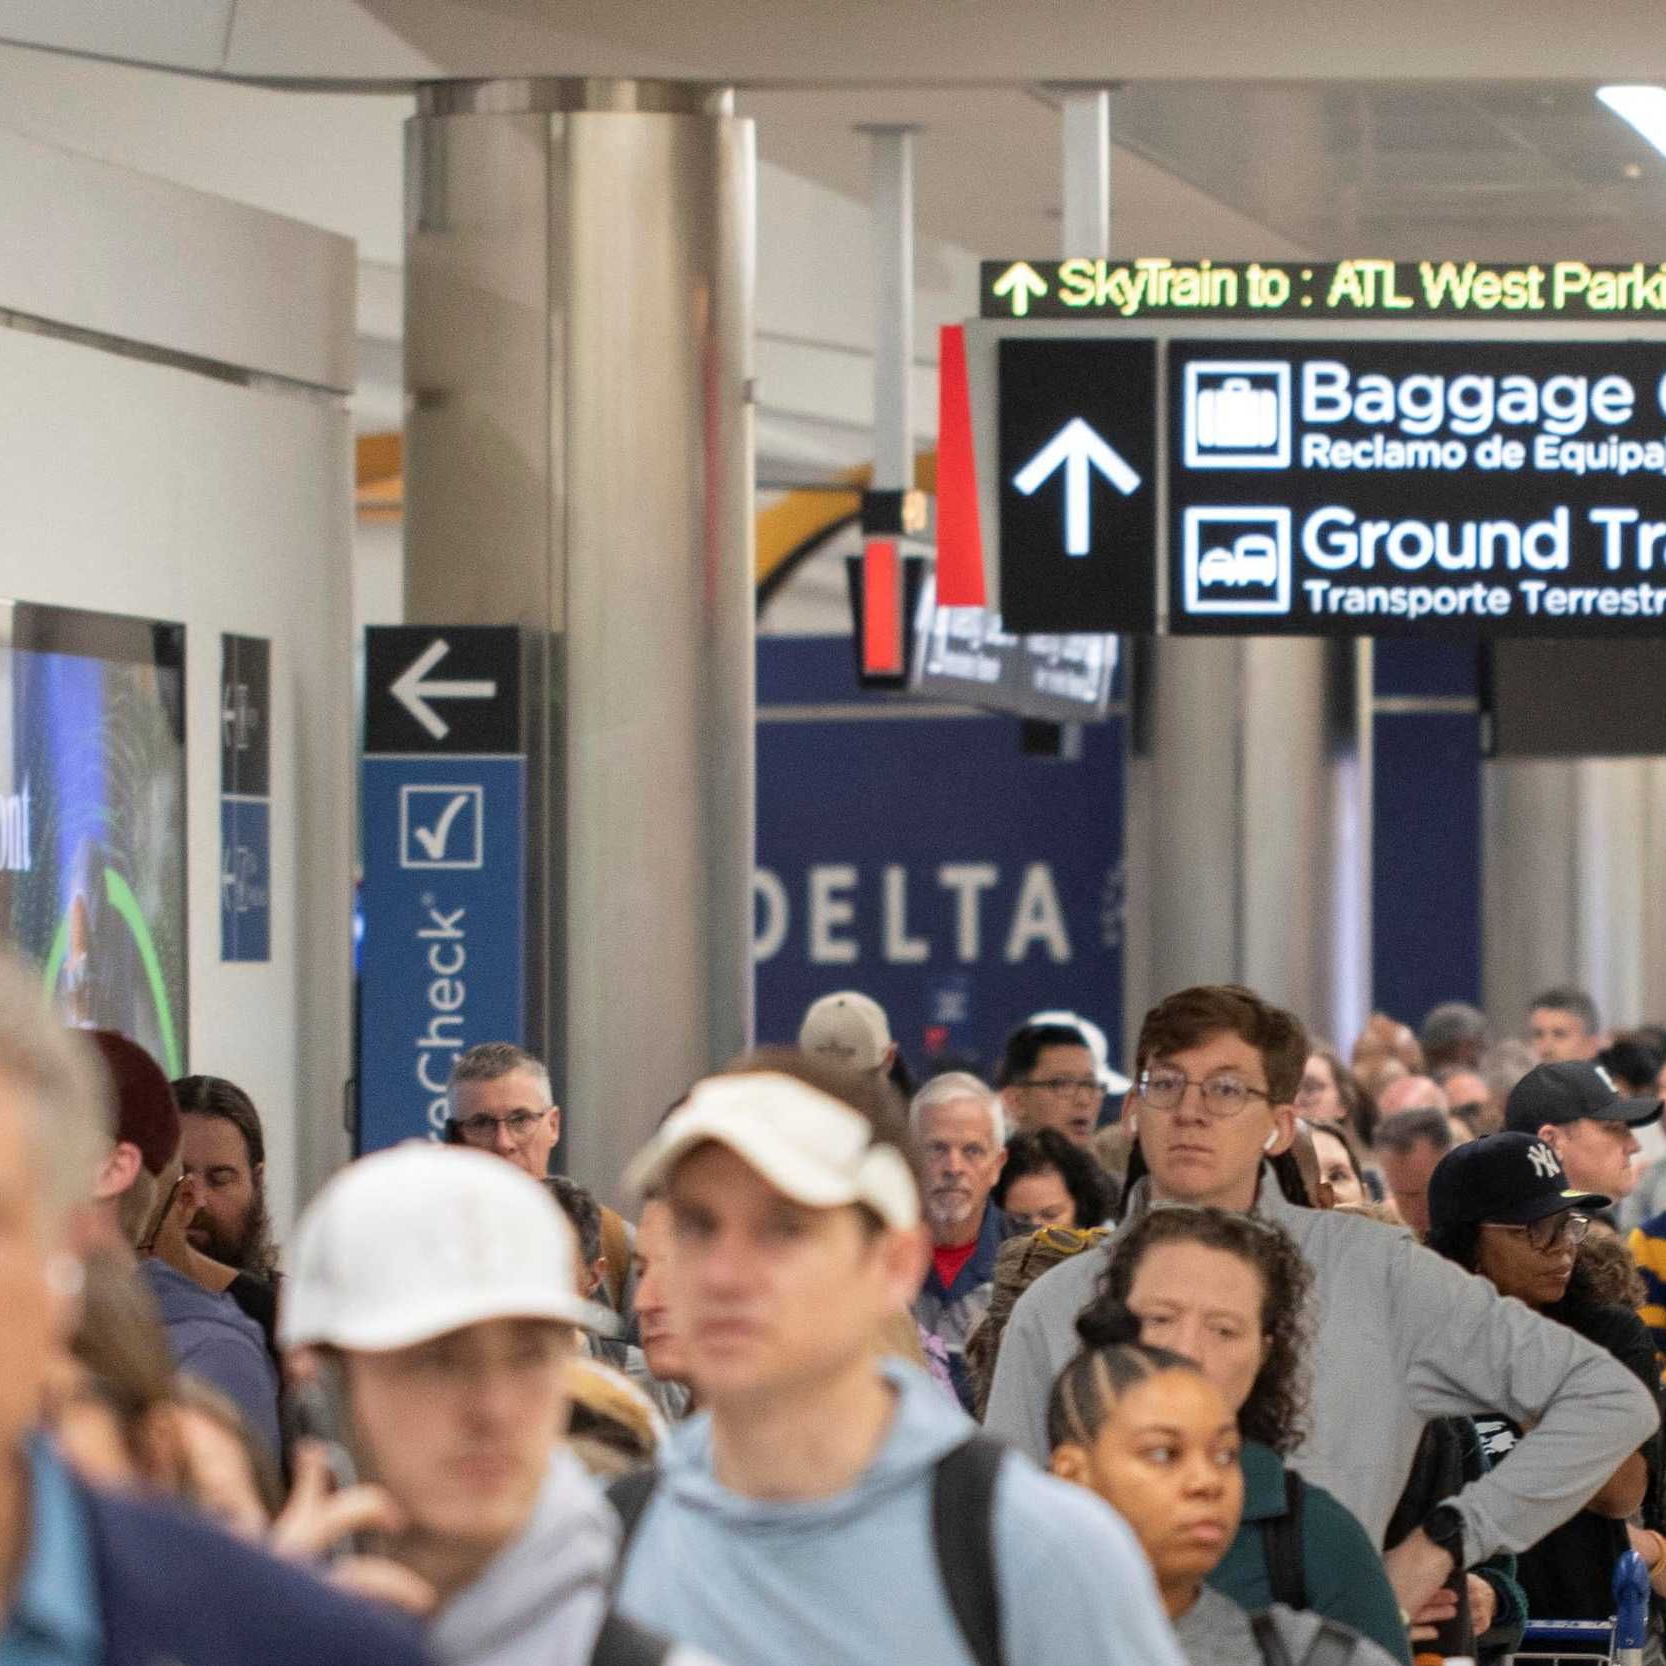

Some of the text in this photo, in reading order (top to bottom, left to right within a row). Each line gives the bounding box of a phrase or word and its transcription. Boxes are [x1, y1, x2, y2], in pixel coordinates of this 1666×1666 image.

[1059, 261, 1238, 316] SkyTrain
[1245, 264, 1290, 308] to
[1327, 260, 1413, 309] ATL
[1421, 261, 1546, 309] West
[1301, 360, 1636, 435] Baggage
[1301, 433, 1468, 470] Reclamo
[1474, 433, 1527, 470] de
[1301, 505, 1570, 571] Ground
[1302, 580, 1512, 620] Transporte
[754, 863, 1075, 963] DELTA
